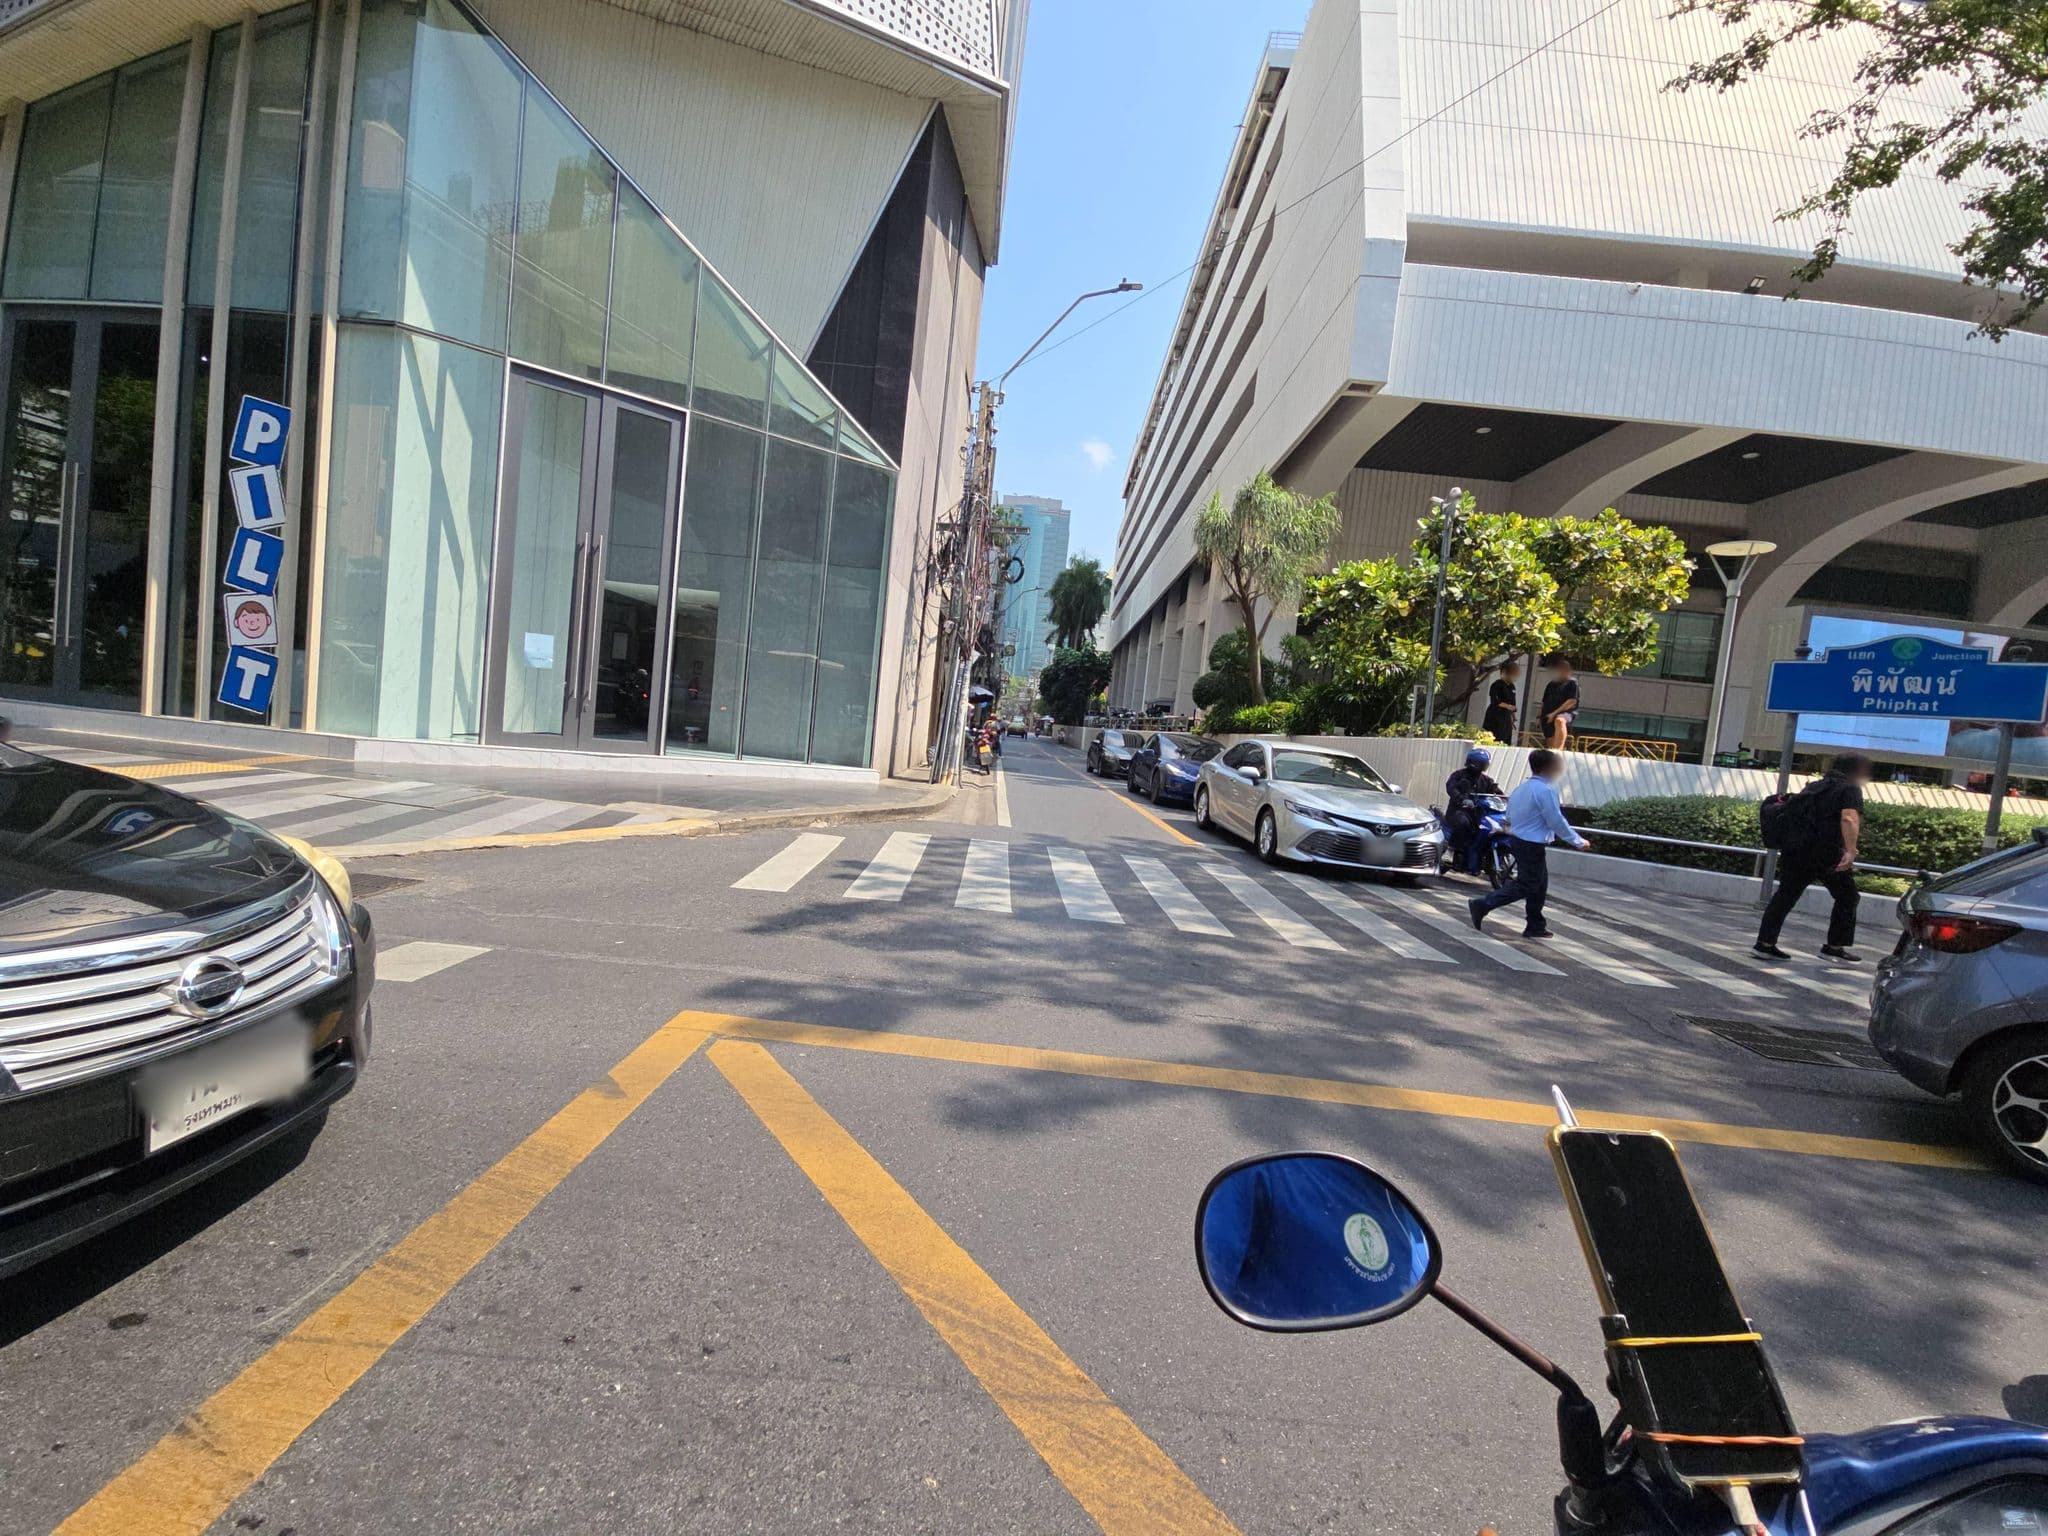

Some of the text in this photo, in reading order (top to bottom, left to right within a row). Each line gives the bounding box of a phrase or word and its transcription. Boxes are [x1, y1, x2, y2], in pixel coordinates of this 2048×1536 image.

[1848, 650, 1876, 660] แยก
[1931, 652, 1983, 661] Junction
[1851, 667, 1963, 696] พิพัฒน์
[1863, 697, 1939, 713] Phiphat
